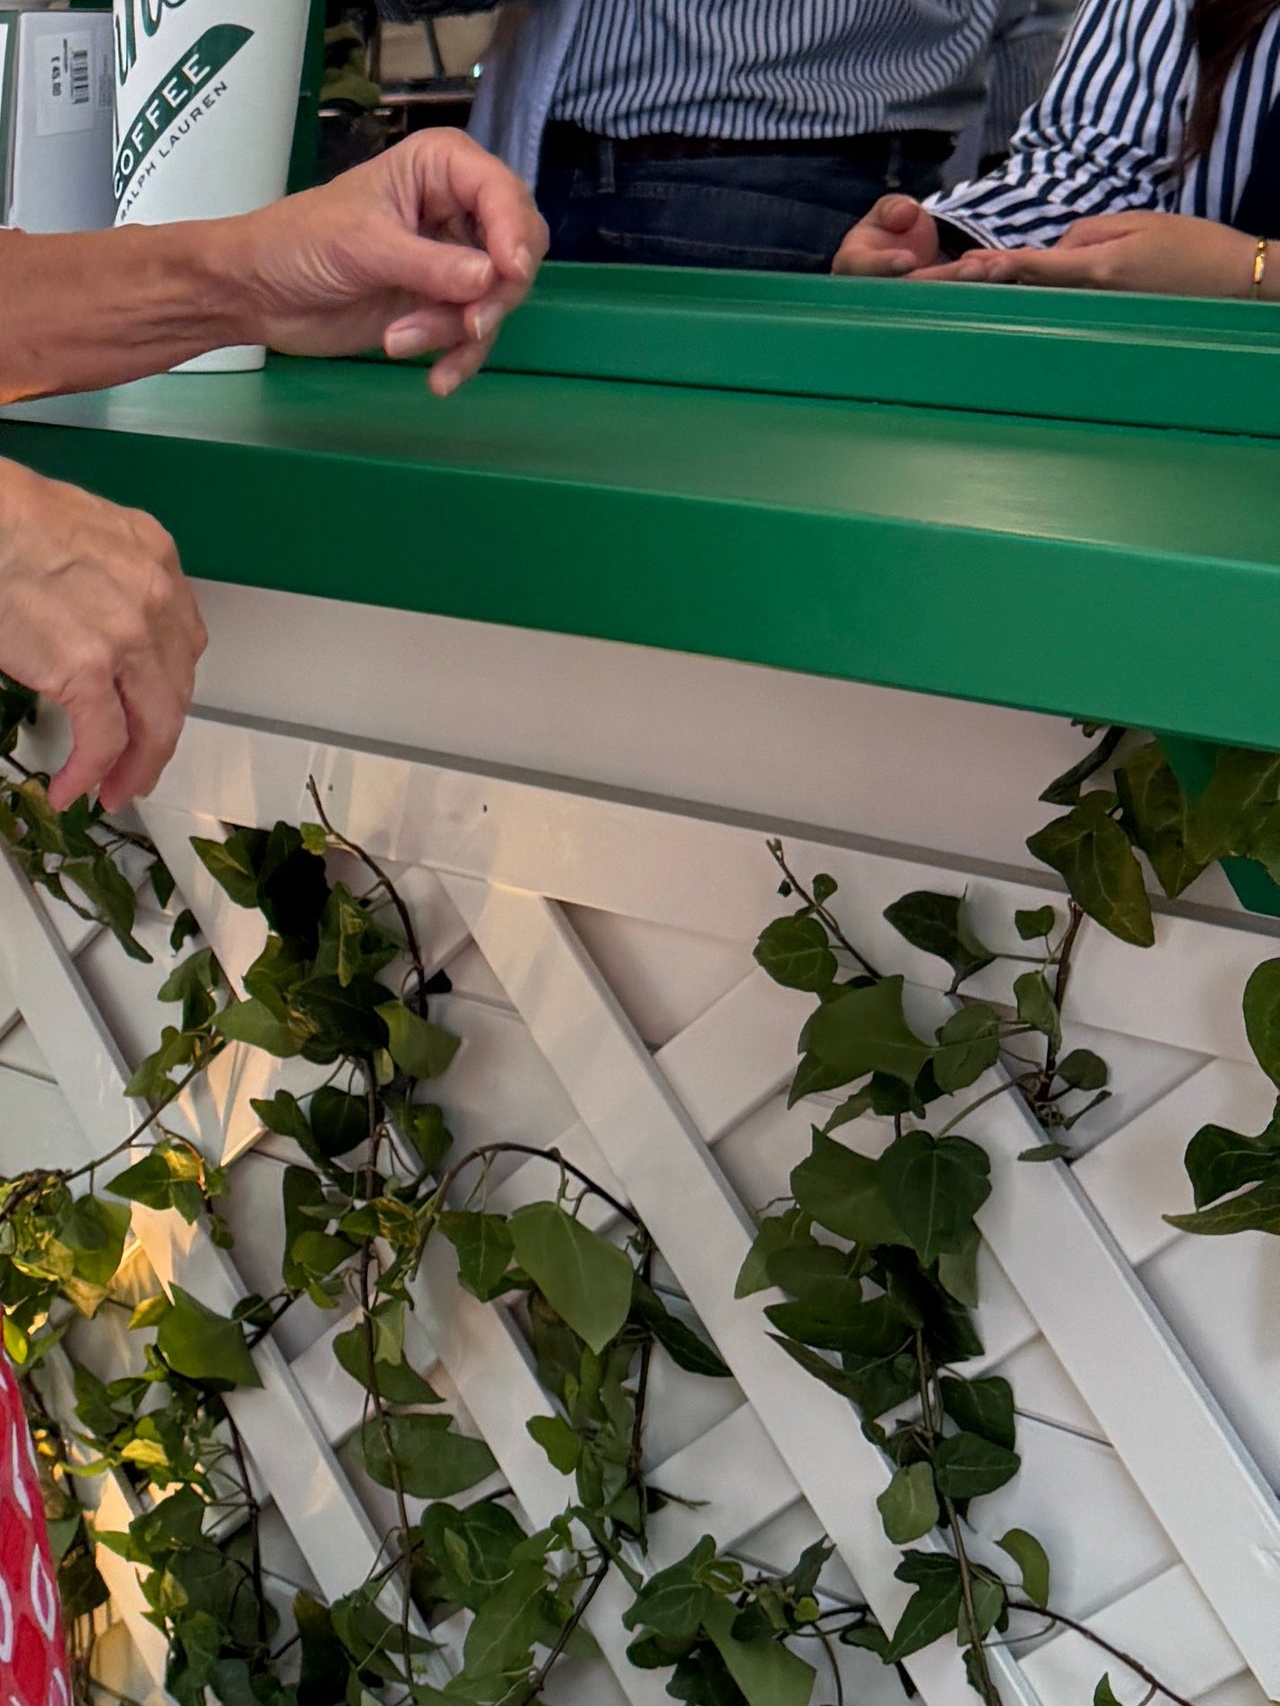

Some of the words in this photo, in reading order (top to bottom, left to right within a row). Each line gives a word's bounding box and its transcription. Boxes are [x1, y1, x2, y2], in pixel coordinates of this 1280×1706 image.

[114, 52, 210, 199] COFFEE
[119, 162, 157, 223] RALPH
[159, 79, 229, 159] LAUREN
